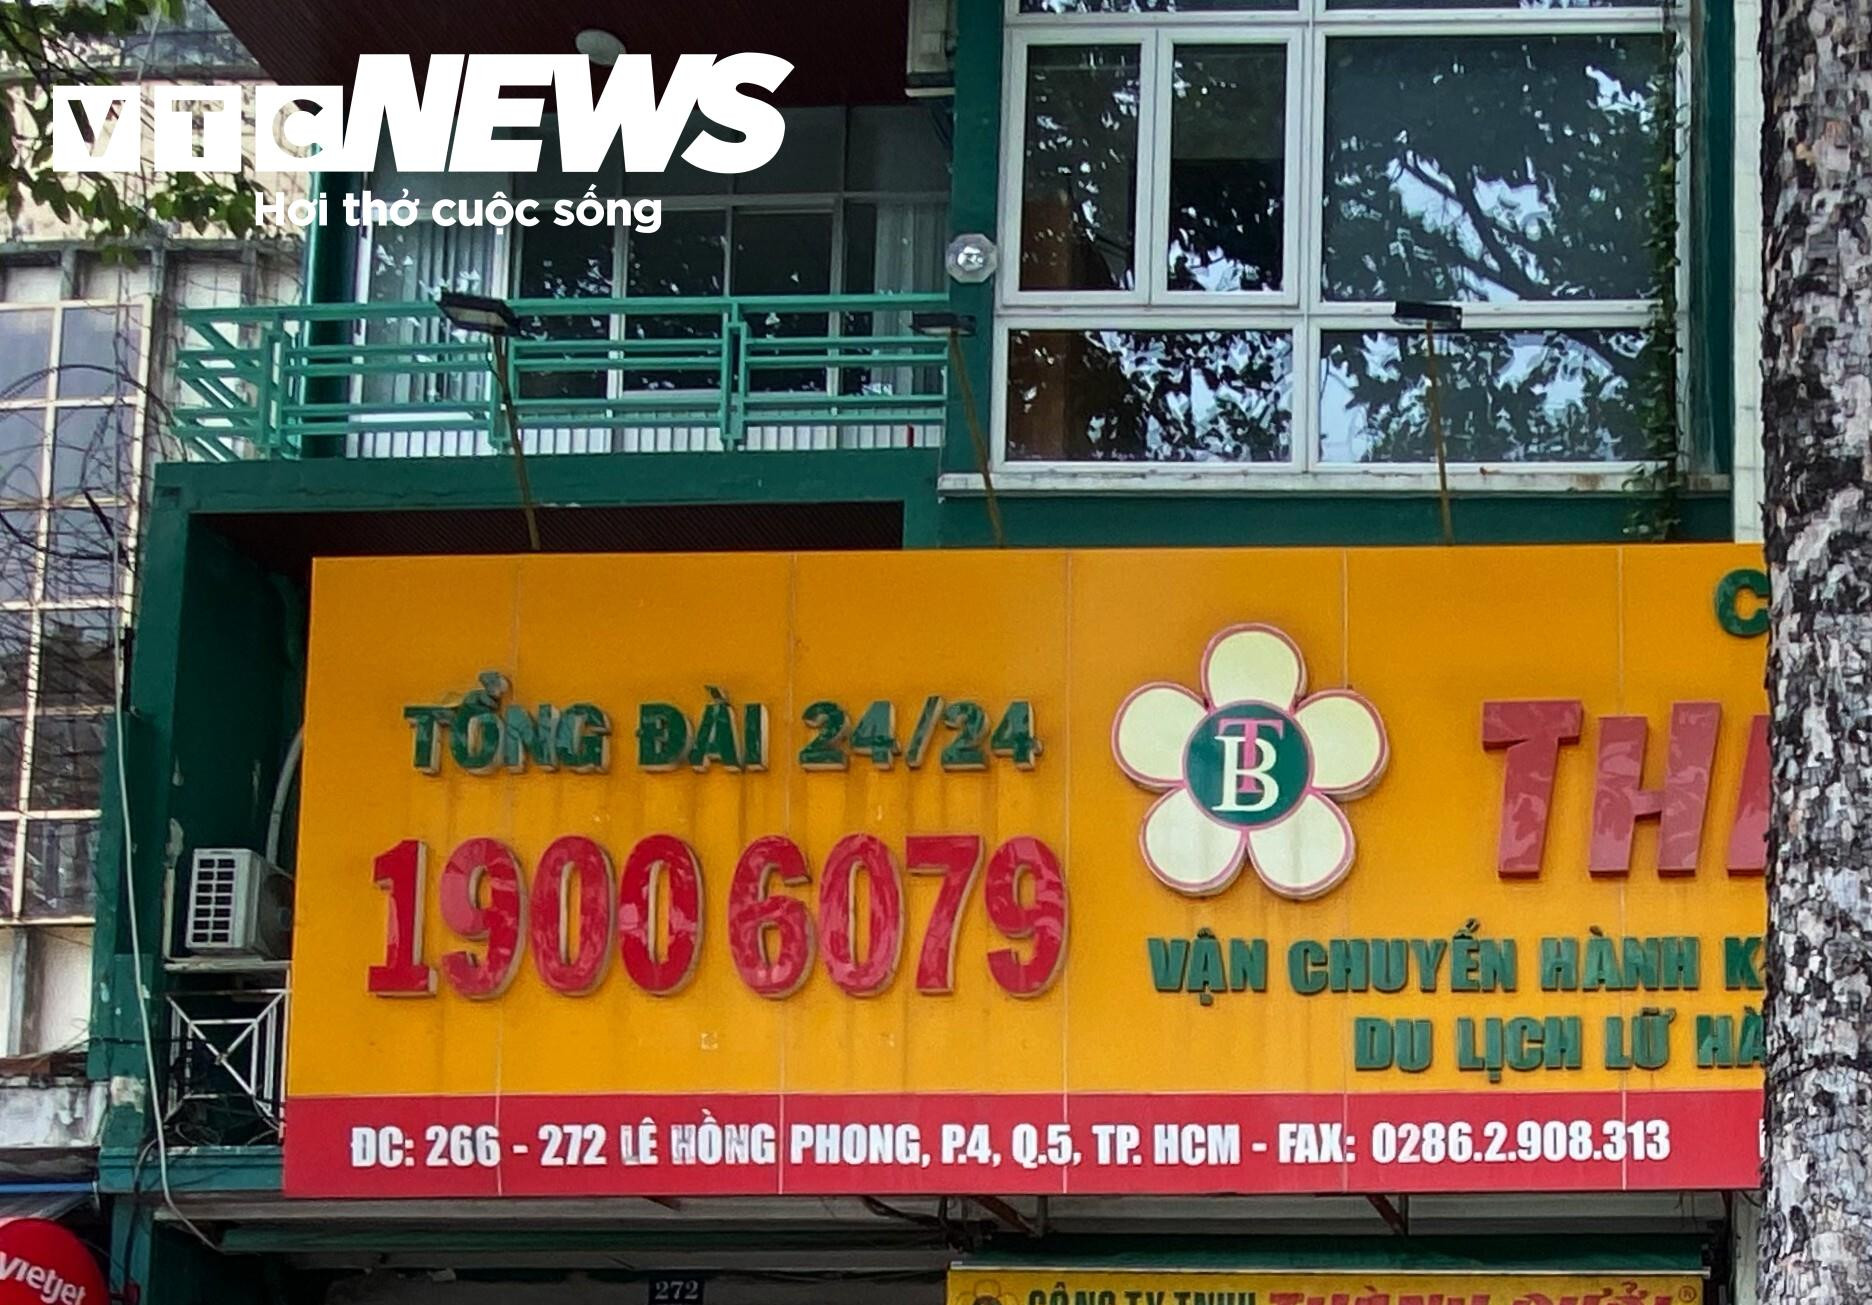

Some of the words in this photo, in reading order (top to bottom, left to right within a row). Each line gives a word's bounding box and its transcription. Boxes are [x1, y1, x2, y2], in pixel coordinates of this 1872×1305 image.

[404, 671, 612, 775] TỔNG
[636, 685, 768, 773] ĐÀI
[799, 696, 1044, 772] 24/24
[368, 834, 705, 999] 1900
[728, 834, 1067, 999] 6079
[1148, 927, 1268, 1006] VẬN
[1541, 926, 1699, 992] HÀNH
[1355, 1016, 1433, 1072] DU
[1457, 1016, 1583, 1083] LỊCH
[1605, 1007, 1678, 1072] LỮ
[351, 1125, 415, 1167] ĐC:
[425, 1125, 501, 1167] 266
[538, 1124, 607, 1166] 272
[620, 1116, 658, 1167] LÊ
[671, 1108, 776, 1166] HỒNG
[790, 1123, 931, 1168] PHONG,
[941, 1123, 1001, 1167] P.4,
[1011, 1123, 1082, 1169] Q.5,
[1092, 1123, 1142, 1165] TP.
[1153, 1123, 1240, 1166] HCM
[1278, 1122, 1356, 1164] FAX:
[1371, 1119, 1670, 1164] 0286.2.908.313
[655, 1280, 699, 1300] 272
